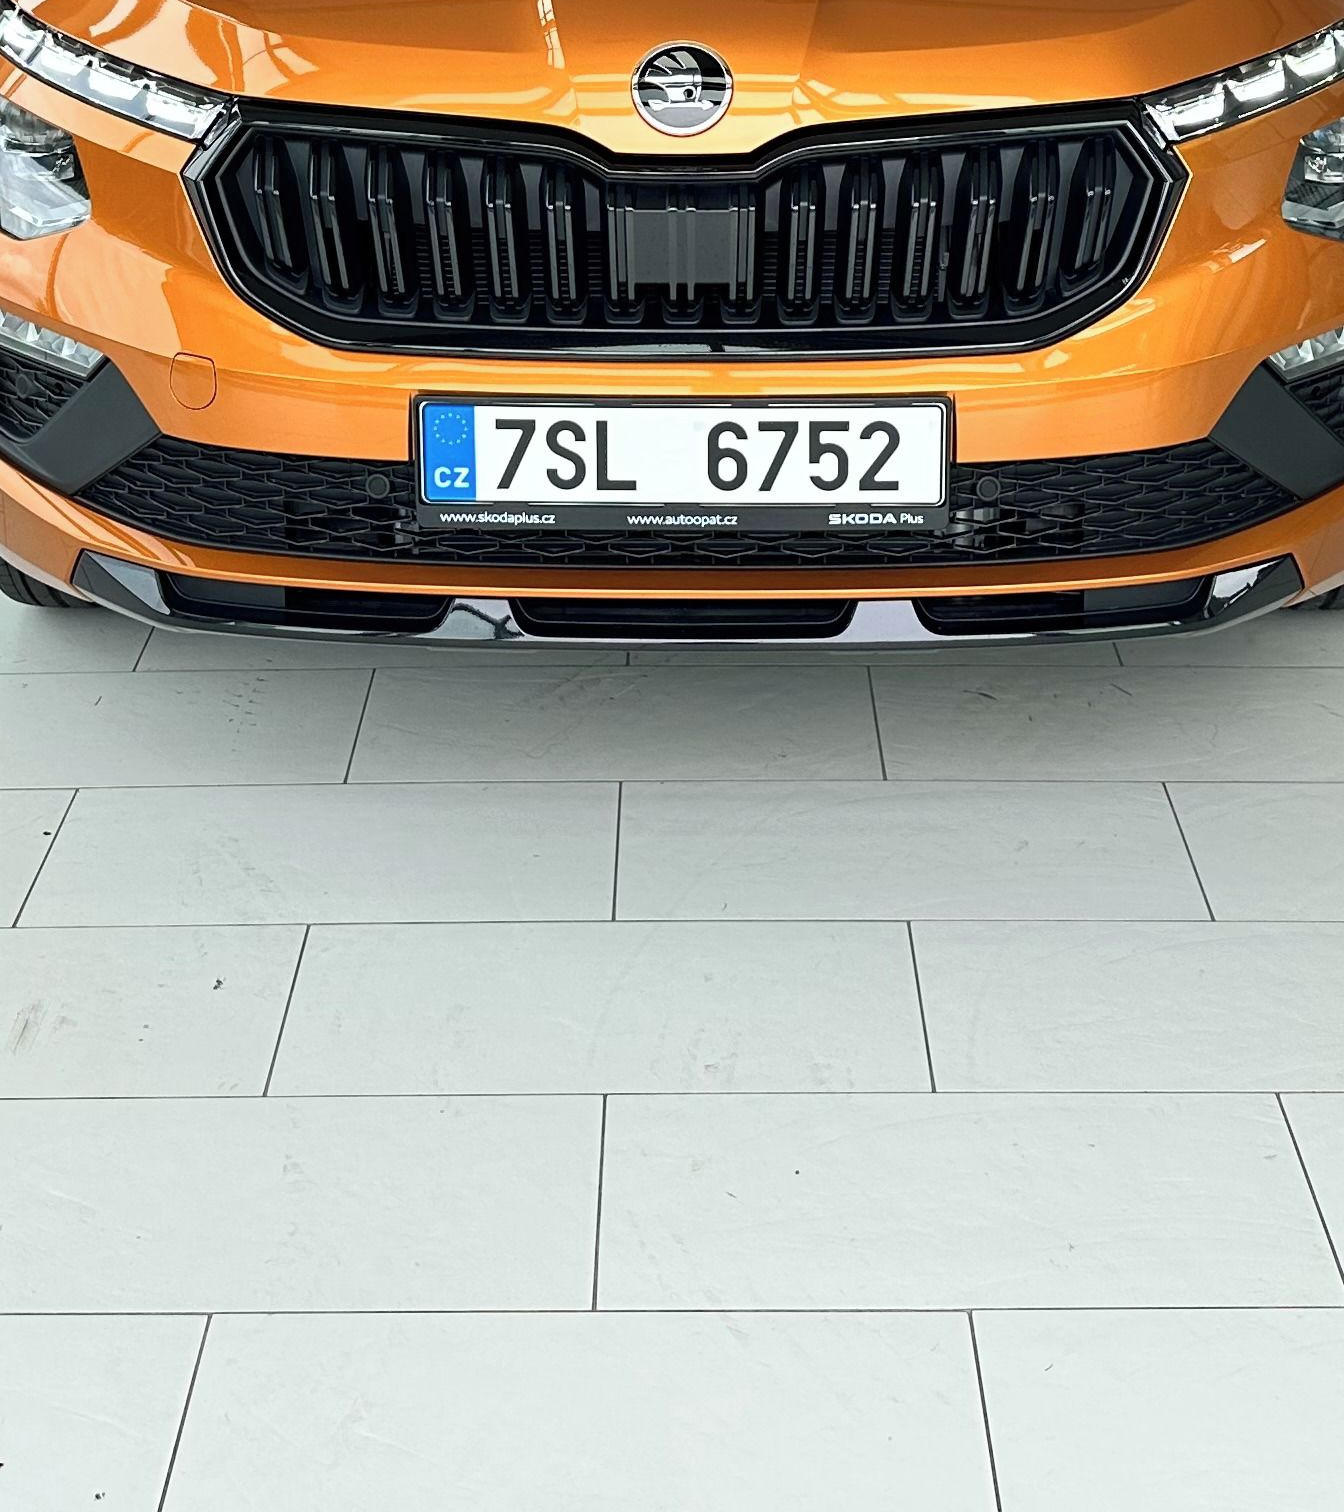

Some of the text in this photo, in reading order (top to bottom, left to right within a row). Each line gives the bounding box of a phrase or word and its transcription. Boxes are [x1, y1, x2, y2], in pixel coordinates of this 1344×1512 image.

[495, 418, 900, 491] 7SL 6752
[433, 466, 470, 488] CZ
[439, 511, 556, 526] www.skodaplus.cz
[626, 514, 738, 527] www.autoopat.cz
[899, 512, 924, 524] Plus
